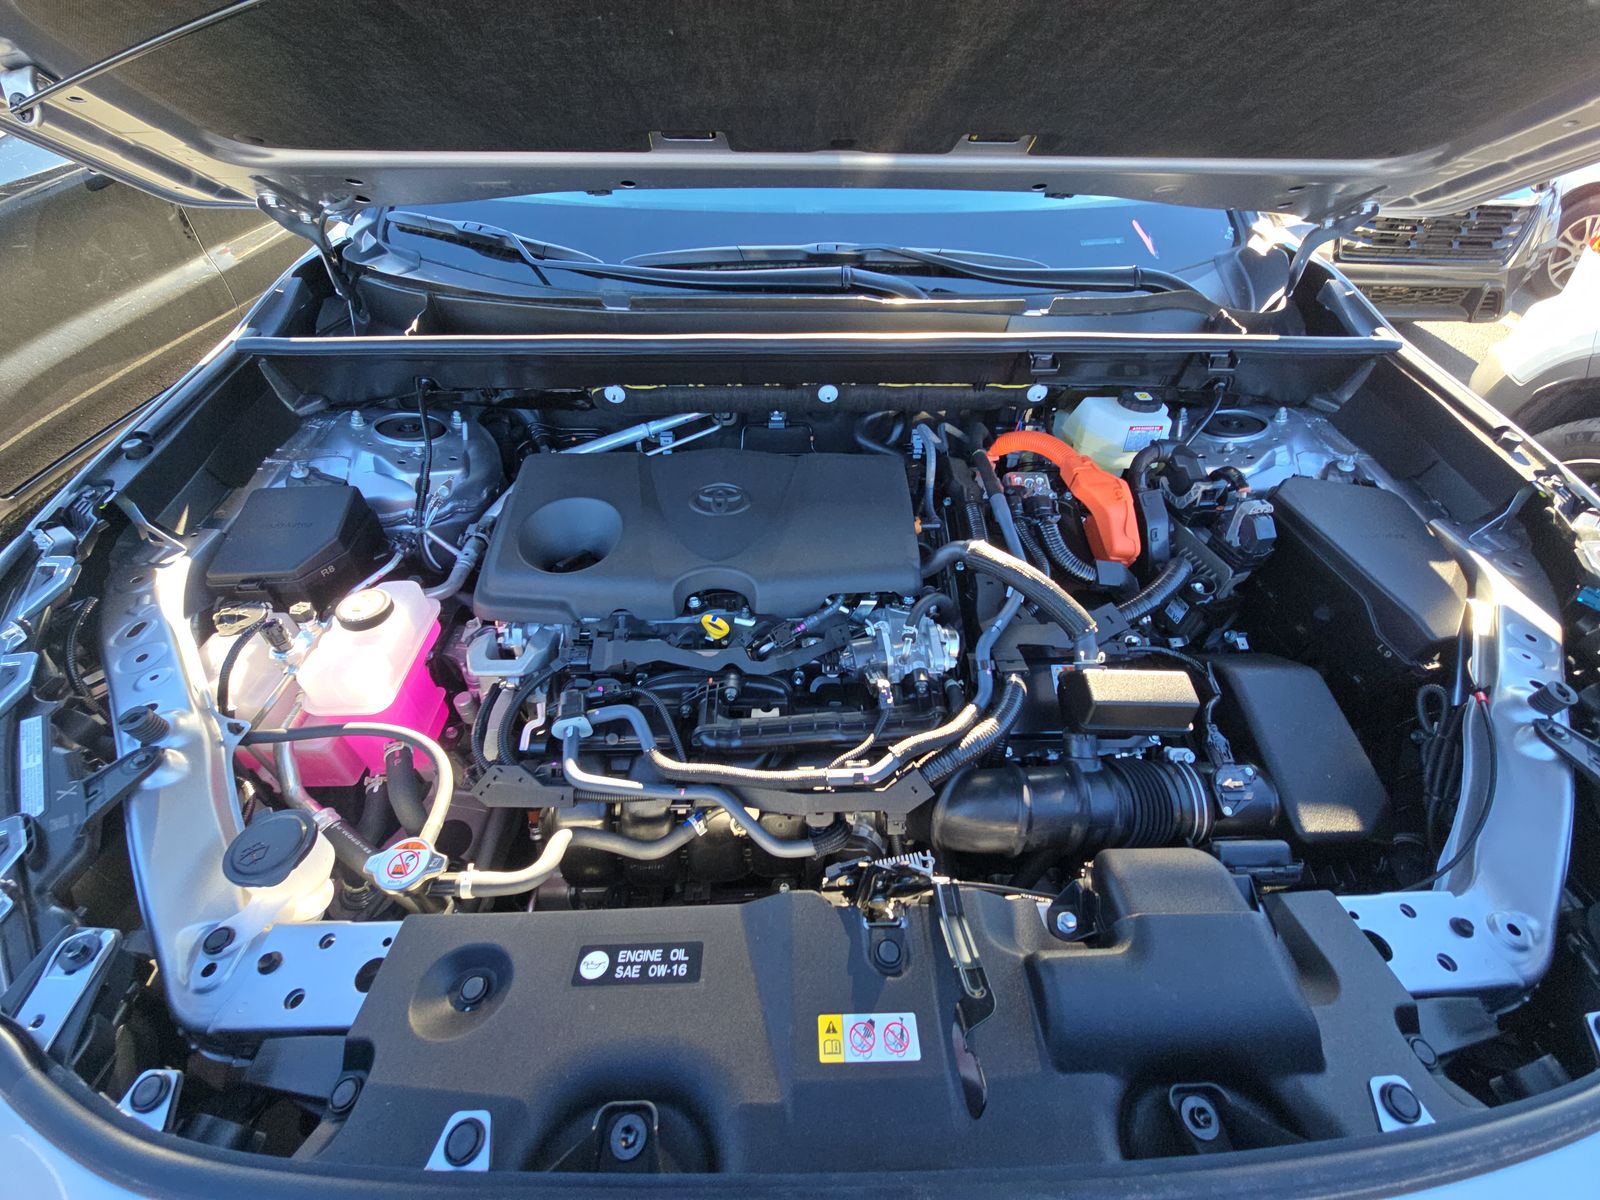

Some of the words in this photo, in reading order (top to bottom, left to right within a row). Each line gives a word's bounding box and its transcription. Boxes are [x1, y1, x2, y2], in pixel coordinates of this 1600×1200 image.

[617, 949, 664, 963] ENGINE
[669, 948, 690, 961] OIL
[614, 965, 642, 979] SAE
[648, 963, 689, 978] 0W-16
